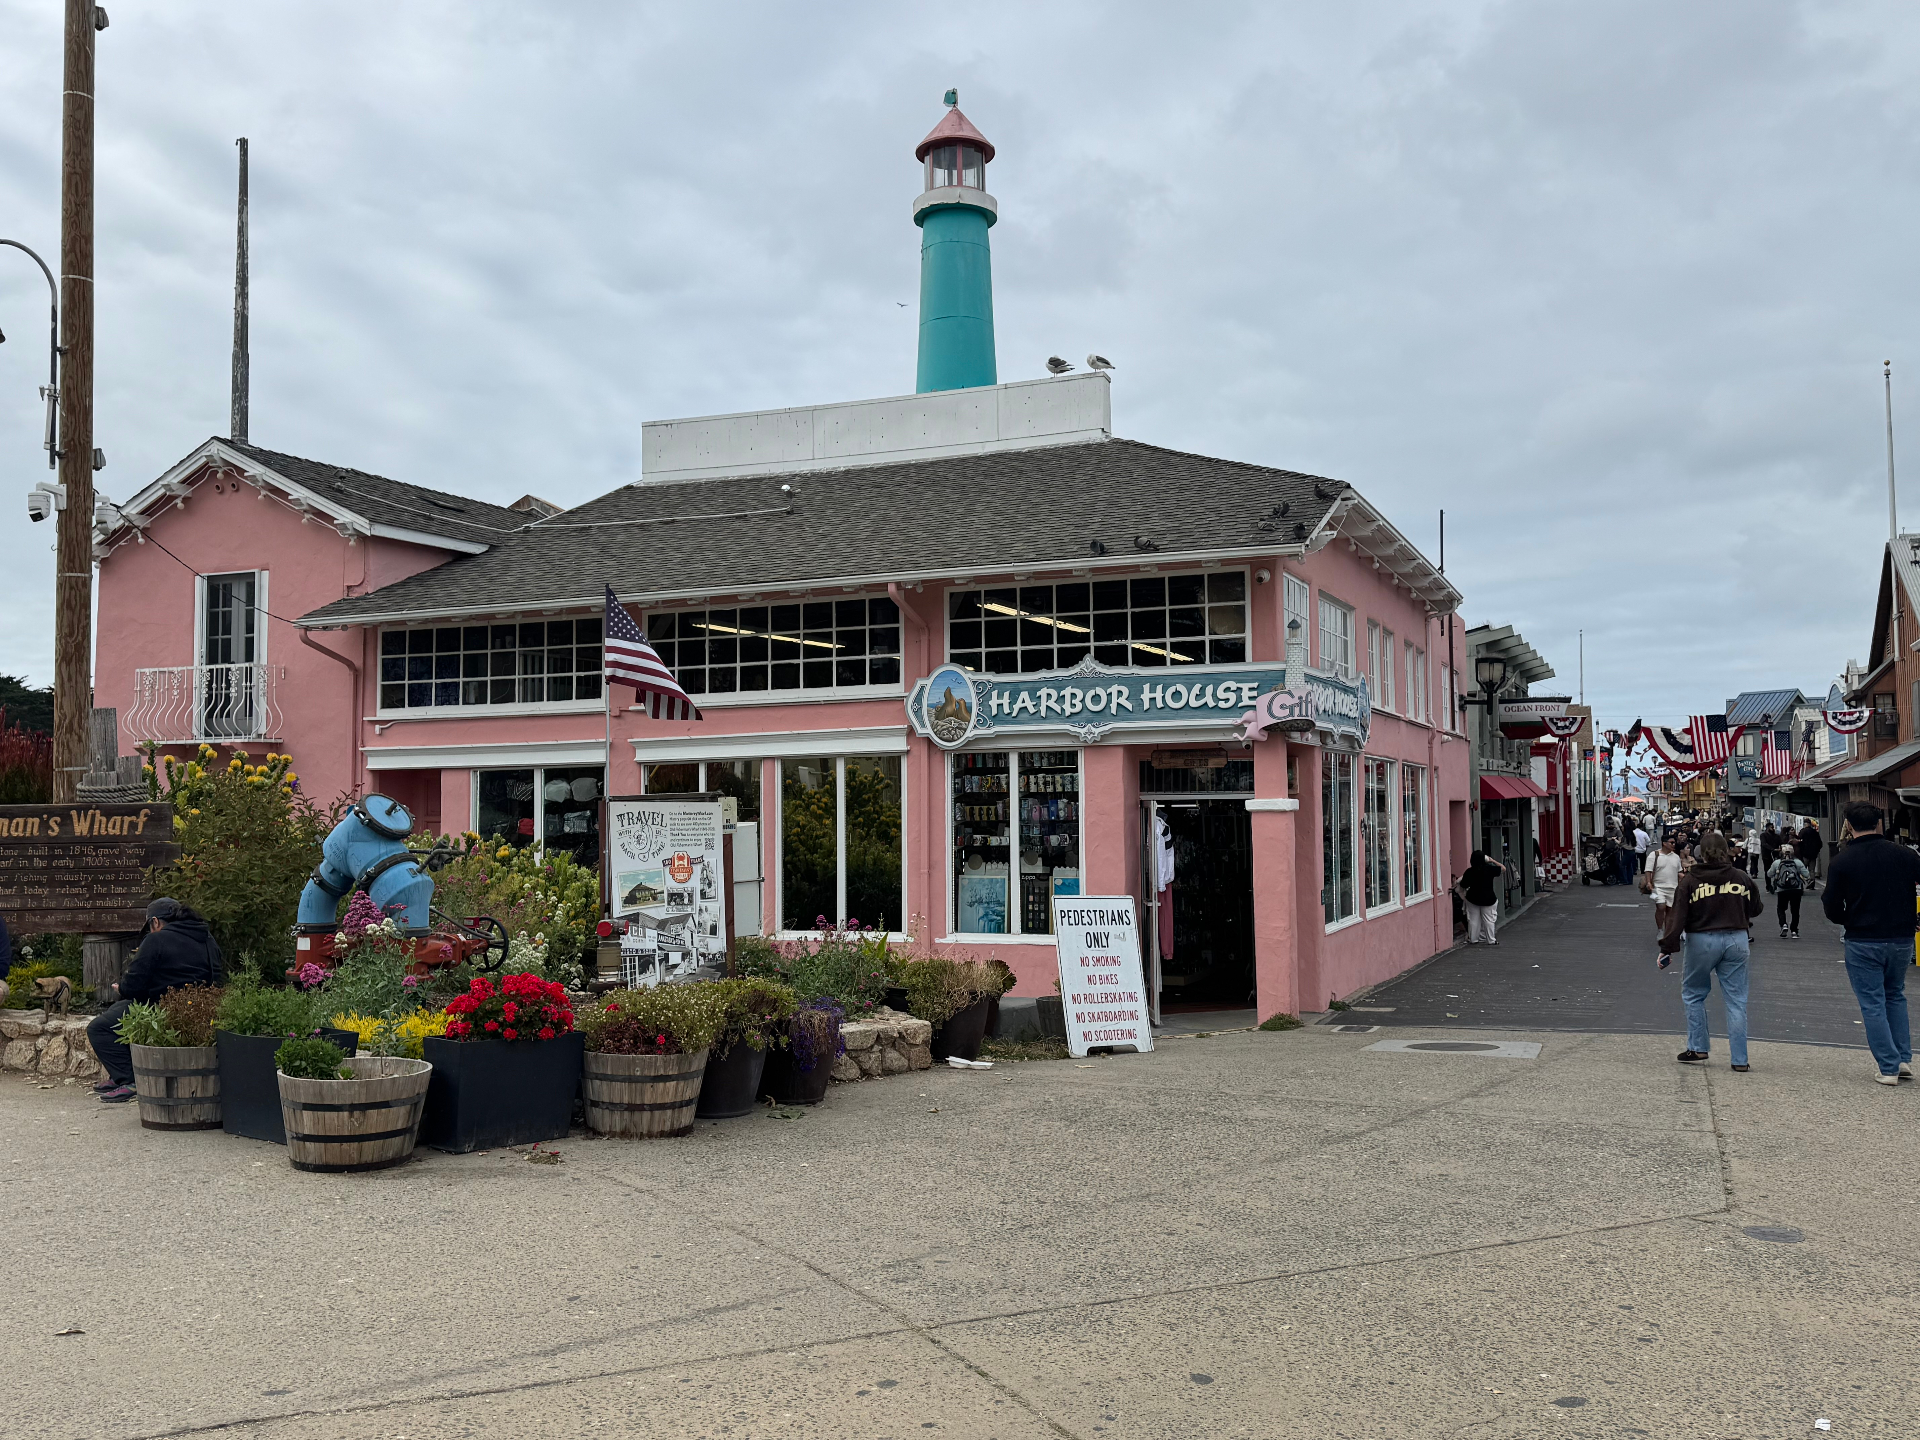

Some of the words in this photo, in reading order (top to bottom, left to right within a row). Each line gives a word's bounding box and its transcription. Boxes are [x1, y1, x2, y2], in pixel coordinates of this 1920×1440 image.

[989, 683, 1132, 718] HARBOR
[1140, 680, 1258, 711] HOUSE
[1504, 704, 1533, 713] OCEAN
[1535, 704, 1561, 712] FRONT
[70, 808, 151, 836] Wharf
[616, 811, 667, 828] TRAVEL
[618, 829, 632, 837] WITH
[27, 846, 48, 856] built
[54, 847, 63, 855] in
[98, 847, 119, 856] gave
[126, 848, 146, 856] way
[620, 842, 636, 860] BACK
[651, 841, 666, 859] TIME
[20, 858, 28, 867] in
[34, 858, 48, 867] the
[82, 857, 110, 866] 1900's
[115, 857, 140, 866] when
[14, 873, 48, 883] fishing
[55, 872, 94, 883] industry
[98, 873, 116, 881] was
[119, 872, 140, 880] born
[24, 886, 49, 898] today
[93, 885, 108, 894] the
[28, 899, 37, 908] to
[101, 913, 118, 921] sea
[1059, 909, 1131, 926] PEDESTRIANS
[1085, 931, 1110, 948] ONLY
[1080, 956, 1089, 967] NO
[1092, 956, 1121, 967] SMOKING
[1087, 974, 1097, 985] NO
[1099, 974, 1119, 985] BIKES
[1071, 993, 1081, 1004] NO
[1083, 991, 1138, 1004] ROLLERSKATING
[1075, 1012, 1085, 1023] NO
[1087, 1009, 1139, 1023] SKATBOARDING
[1082, 1030, 1093, 1042] NO
[1094, 1029, 1137, 1042] SCOOTERING
